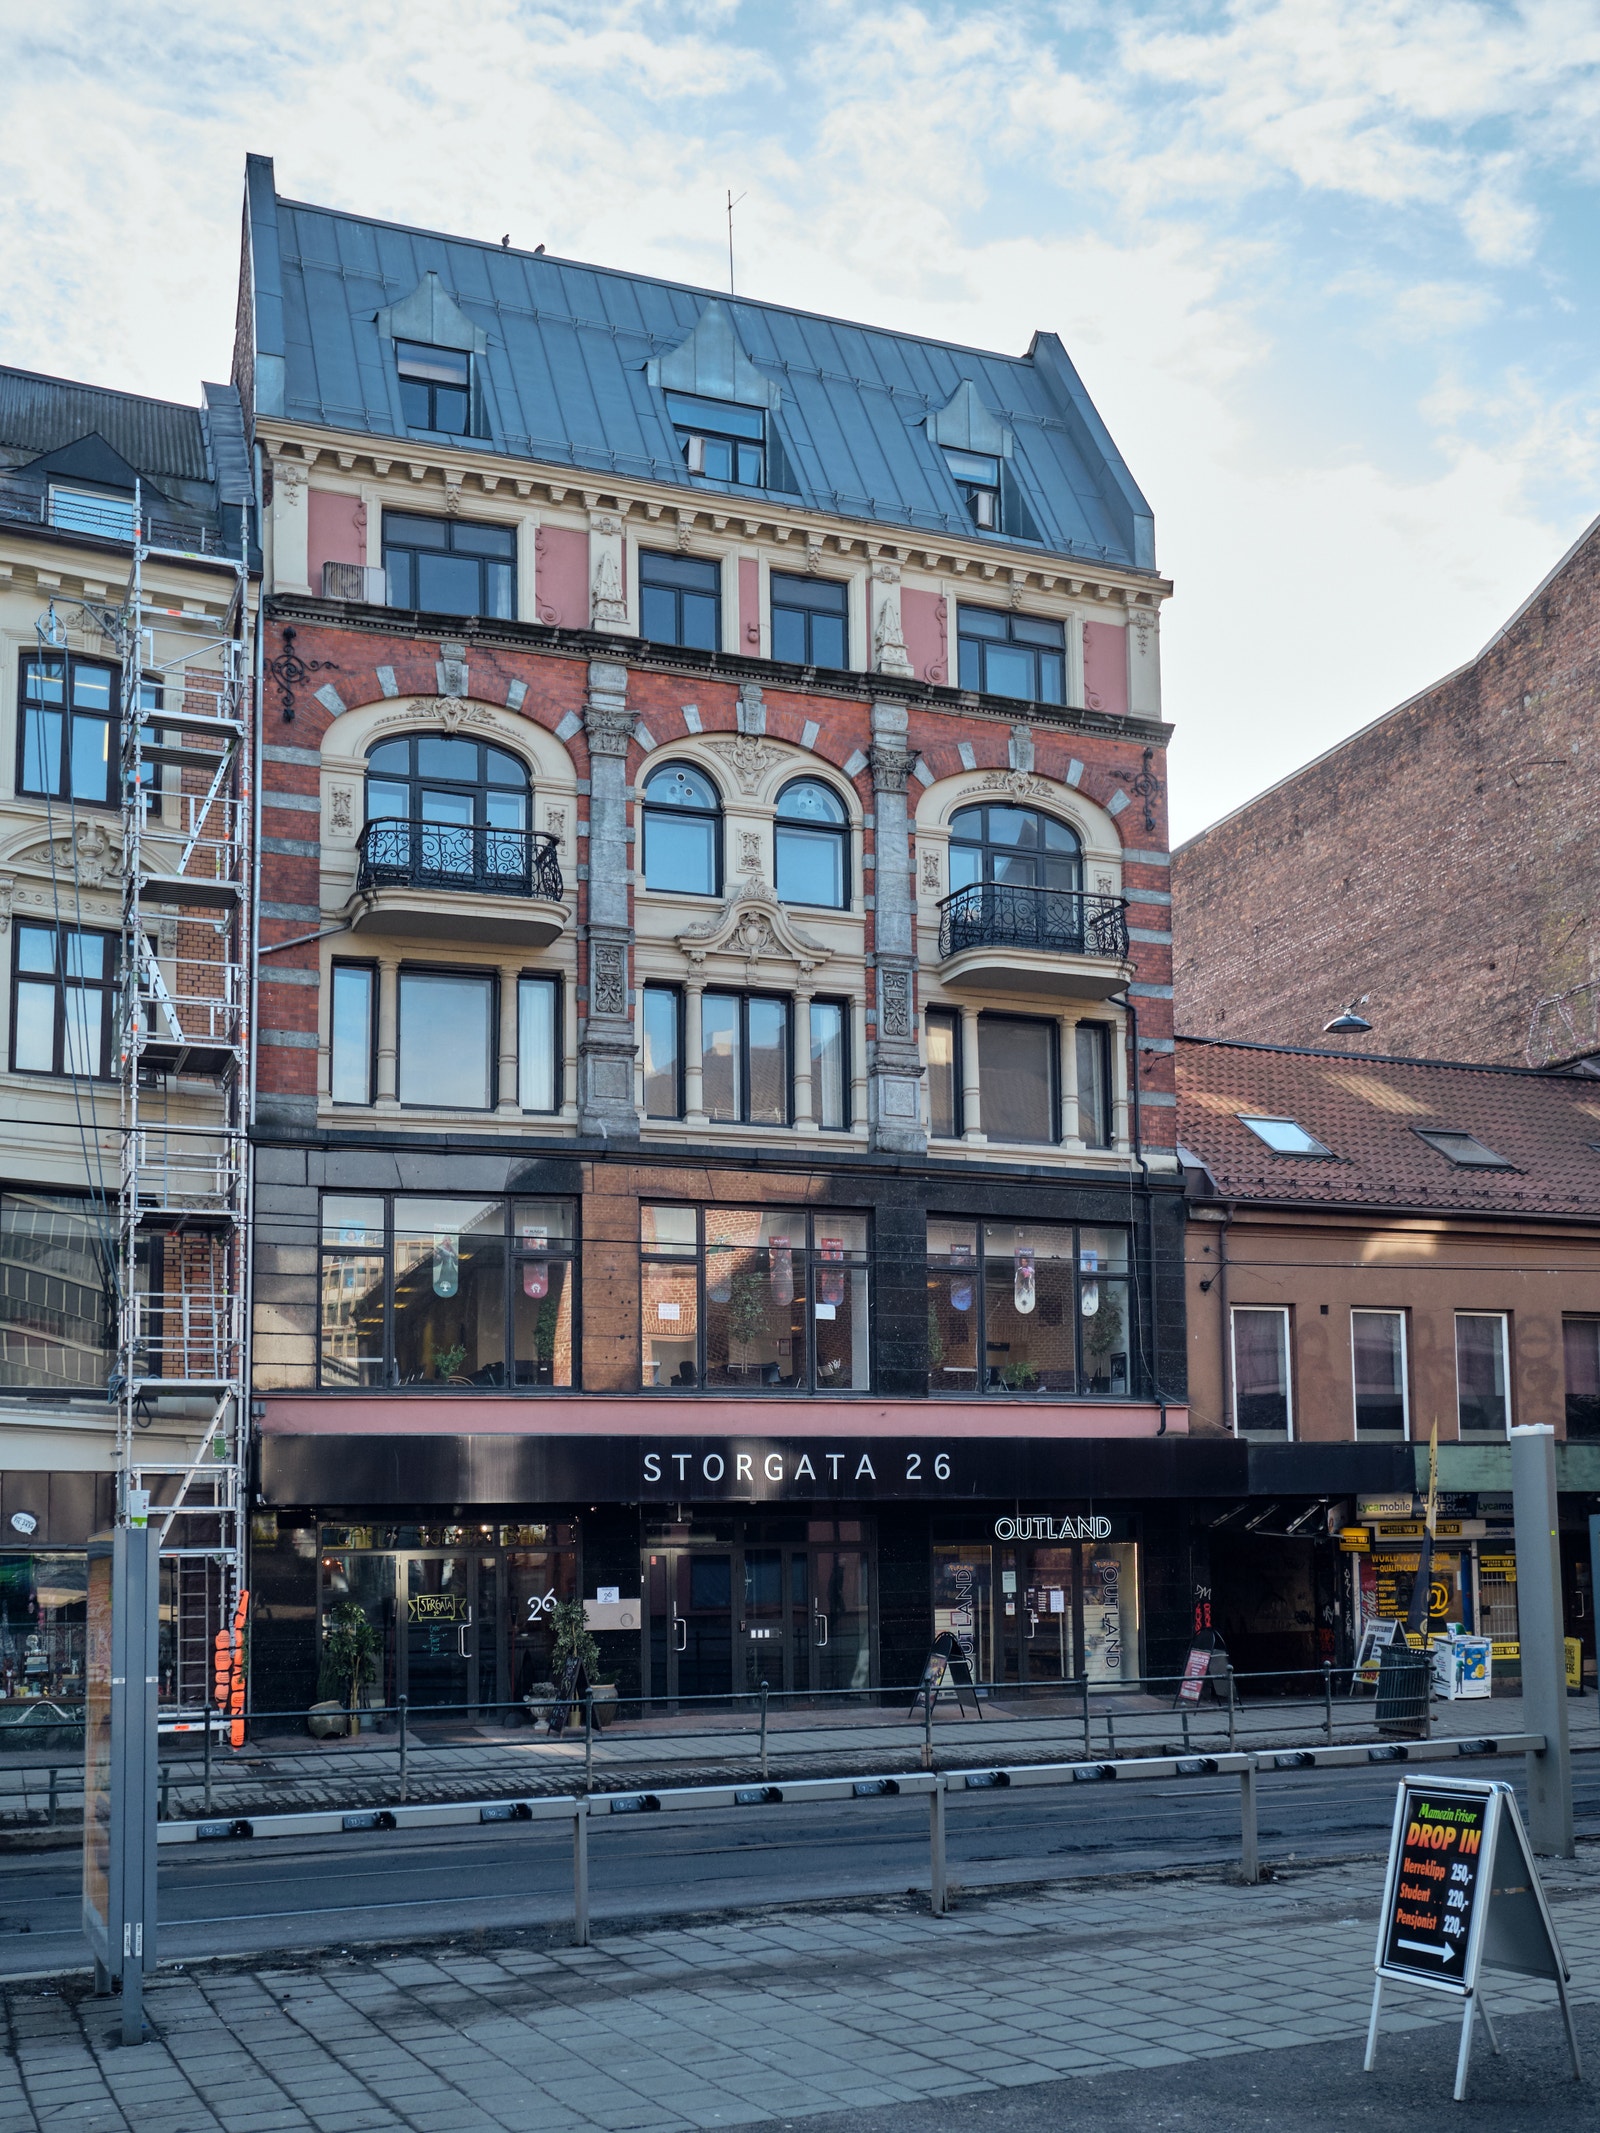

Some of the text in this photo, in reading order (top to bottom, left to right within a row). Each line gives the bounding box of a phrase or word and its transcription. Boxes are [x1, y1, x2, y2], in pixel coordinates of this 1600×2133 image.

[643, 1453, 951, 1482] STORGATA 26
[1357, 1501, 1411, 1513] Lycamobile
[994, 1515, 1112, 1540] OUTLAND
[1372, 1554, 1398, 1562] WORLD
[527, 1587, 558, 1621] 26
[1102, 1566, 1120, 1669] OUTLAND
[1406, 1822, 1482, 1854] DROP IN
[1403, 1857, 1473, 1886] Herreklipp 250,-
[1400, 1882, 1469, 1912] Student 220,-
[1396, 1908, 1465, 1938] Pensjonist 220,-
